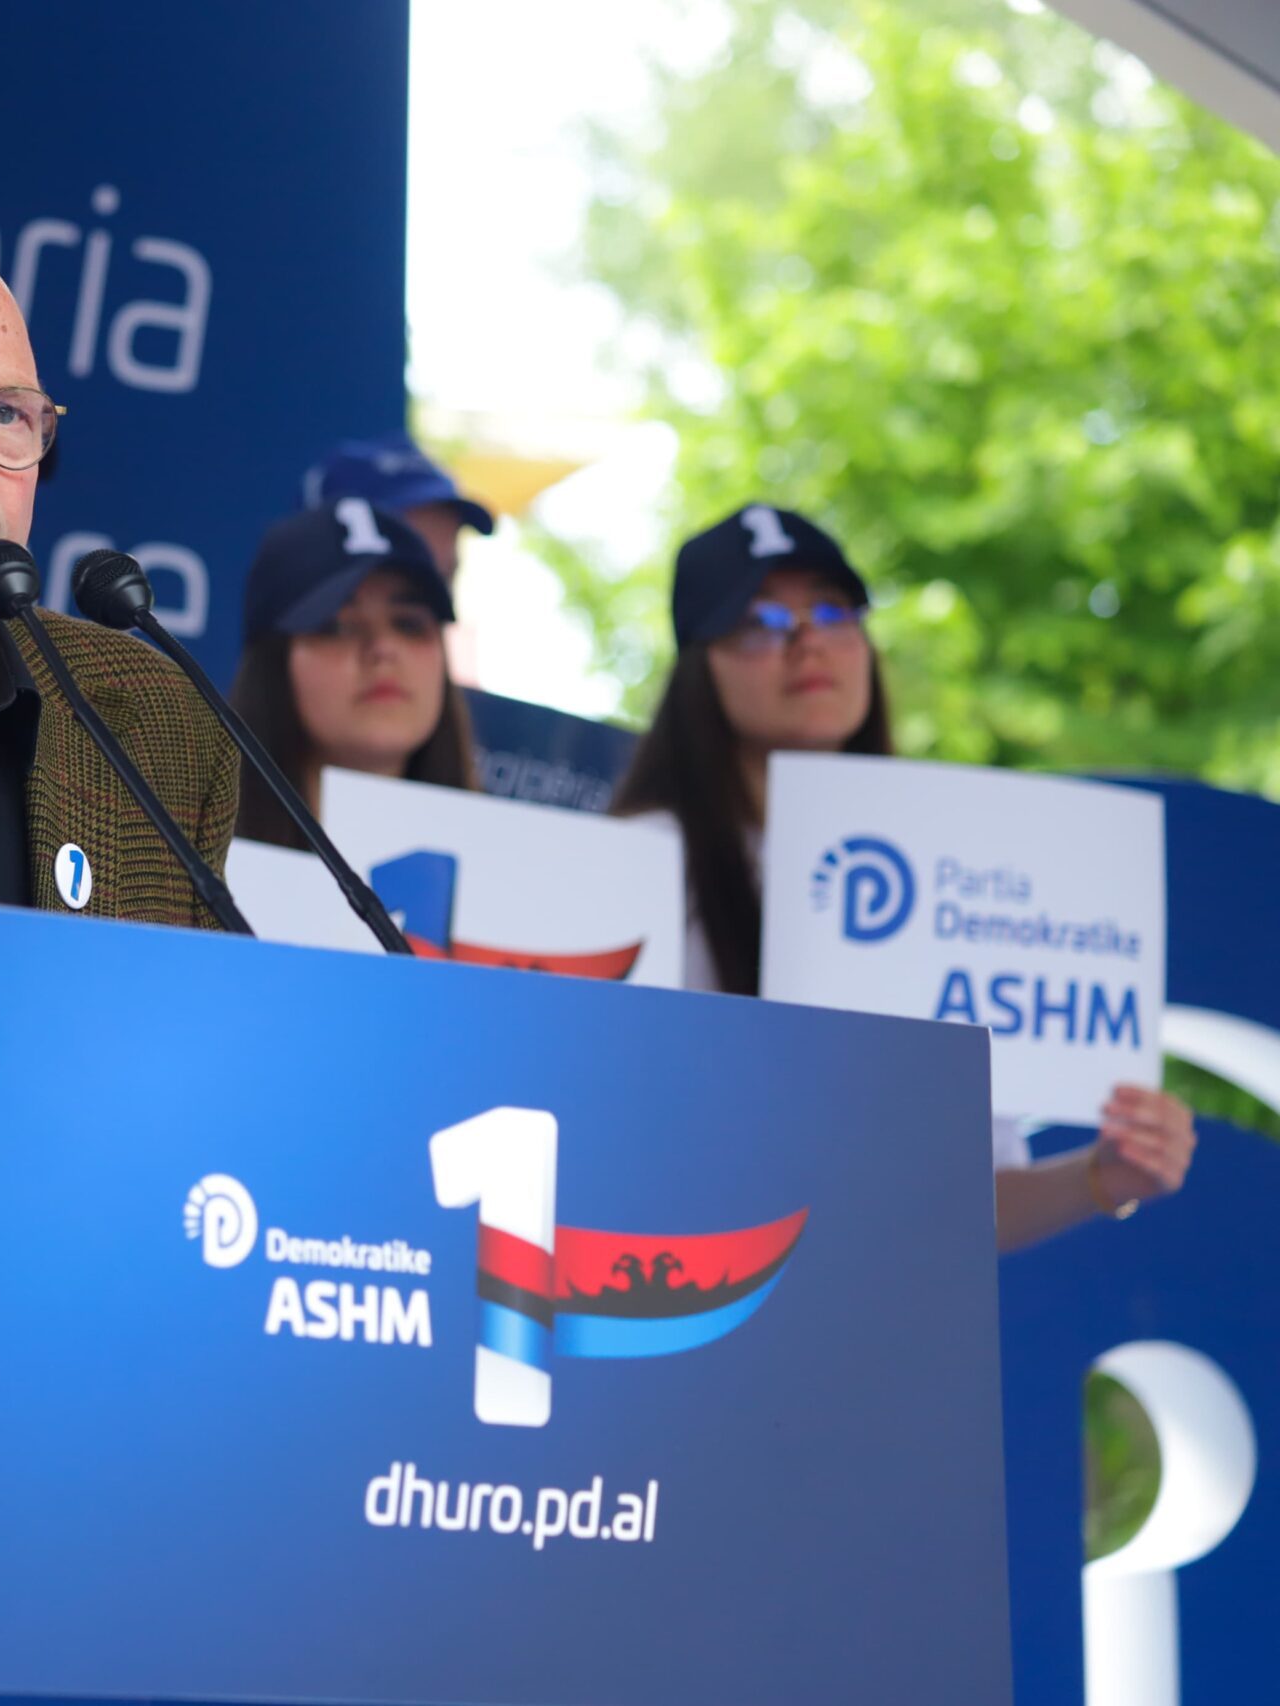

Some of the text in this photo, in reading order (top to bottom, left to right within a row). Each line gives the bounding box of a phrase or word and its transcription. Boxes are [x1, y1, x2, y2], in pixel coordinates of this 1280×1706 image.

[335, 498, 391, 554] 1
[740, 505, 795, 557] 1
[934, 858, 1032, 902] Partia
[934, 902, 1142, 961] Demokratike
[934, 967, 1142, 1050] ASHM
[265, 1227, 432, 1276] Demokratike
[264, 1276, 433, 1348] ASHM
[364, 1460, 659, 1550] dhuro.pd.al
